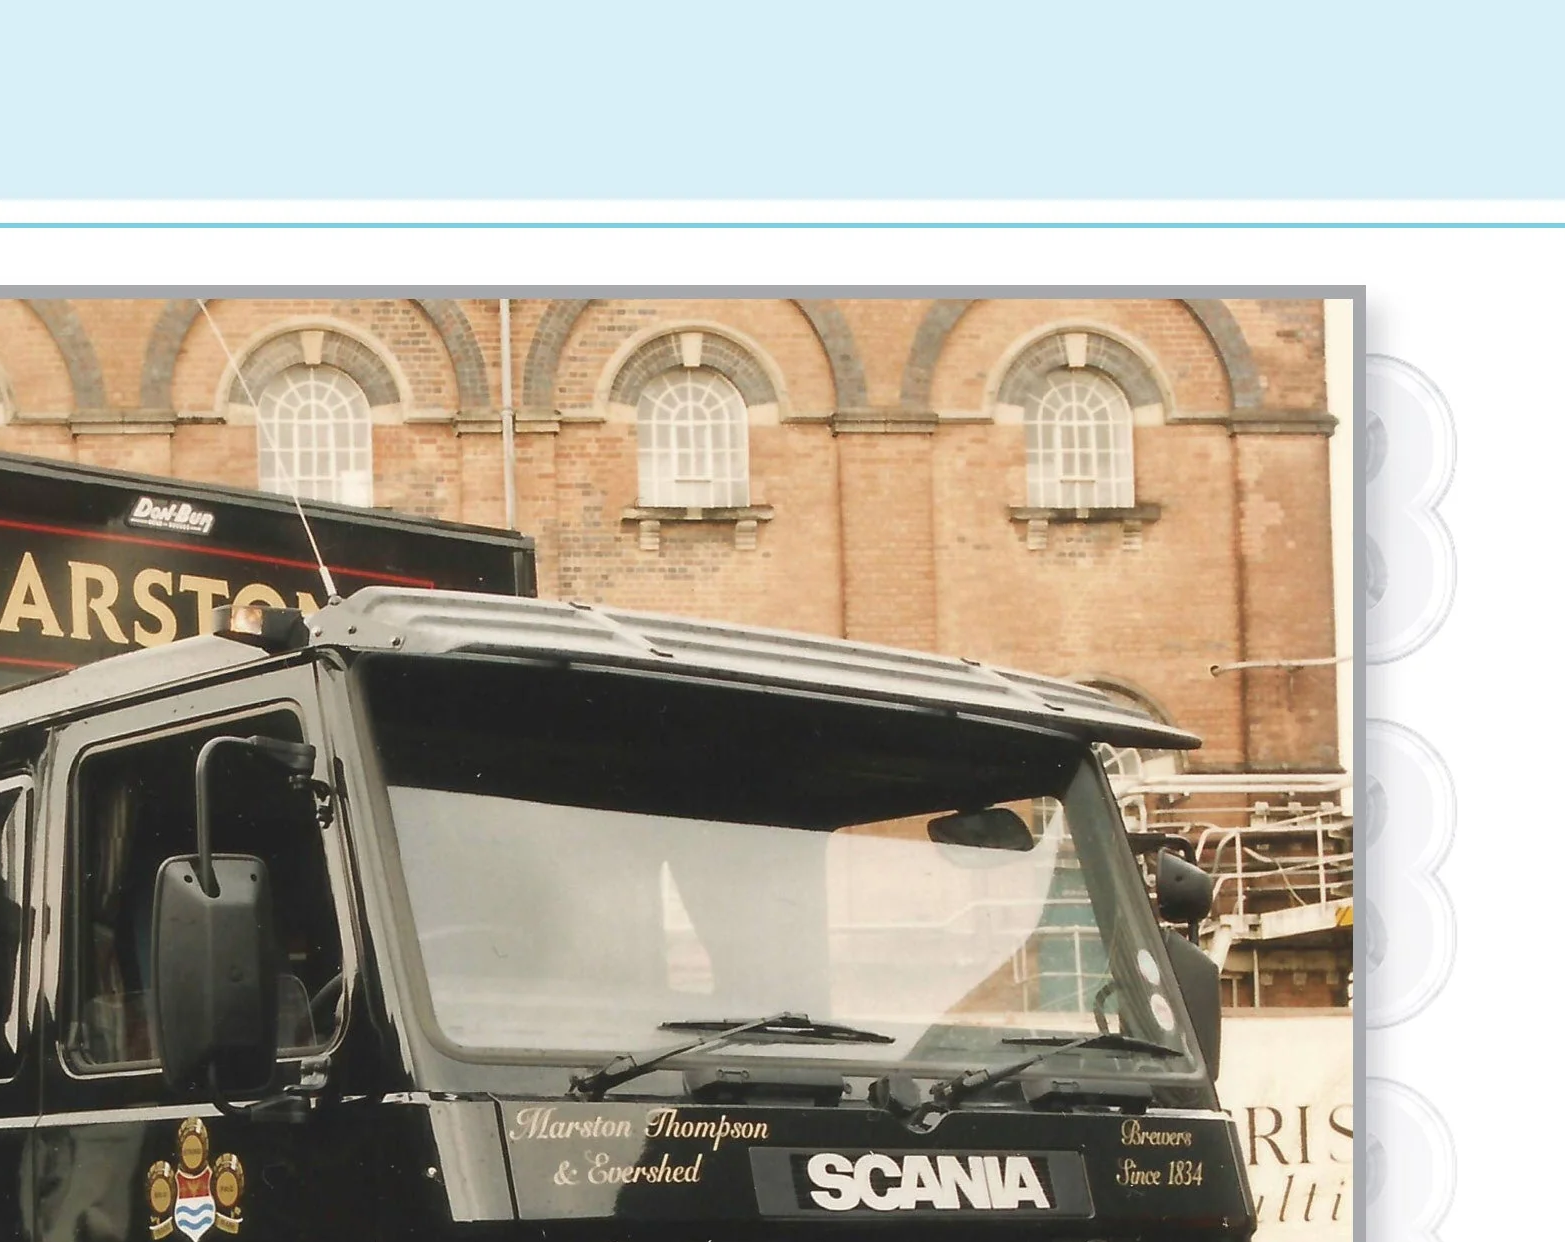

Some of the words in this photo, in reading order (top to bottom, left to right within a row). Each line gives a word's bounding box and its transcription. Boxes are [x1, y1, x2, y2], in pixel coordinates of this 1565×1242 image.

[509, 1107, 631, 1140] Marston
[644, 1108, 769, 1151] Thompson
[1121, 1119, 1192, 1146] Brewers
[1223, 1105, 1353, 1165] RIS
[553, 1159, 581, 1186] &
[584, 1149, 703, 1185] Evershed
[807, 1152, 1051, 1212] SCANIA
[1116, 1158, 1161, 1186] Since
[1168, 1160, 1203, 1186] 1834
